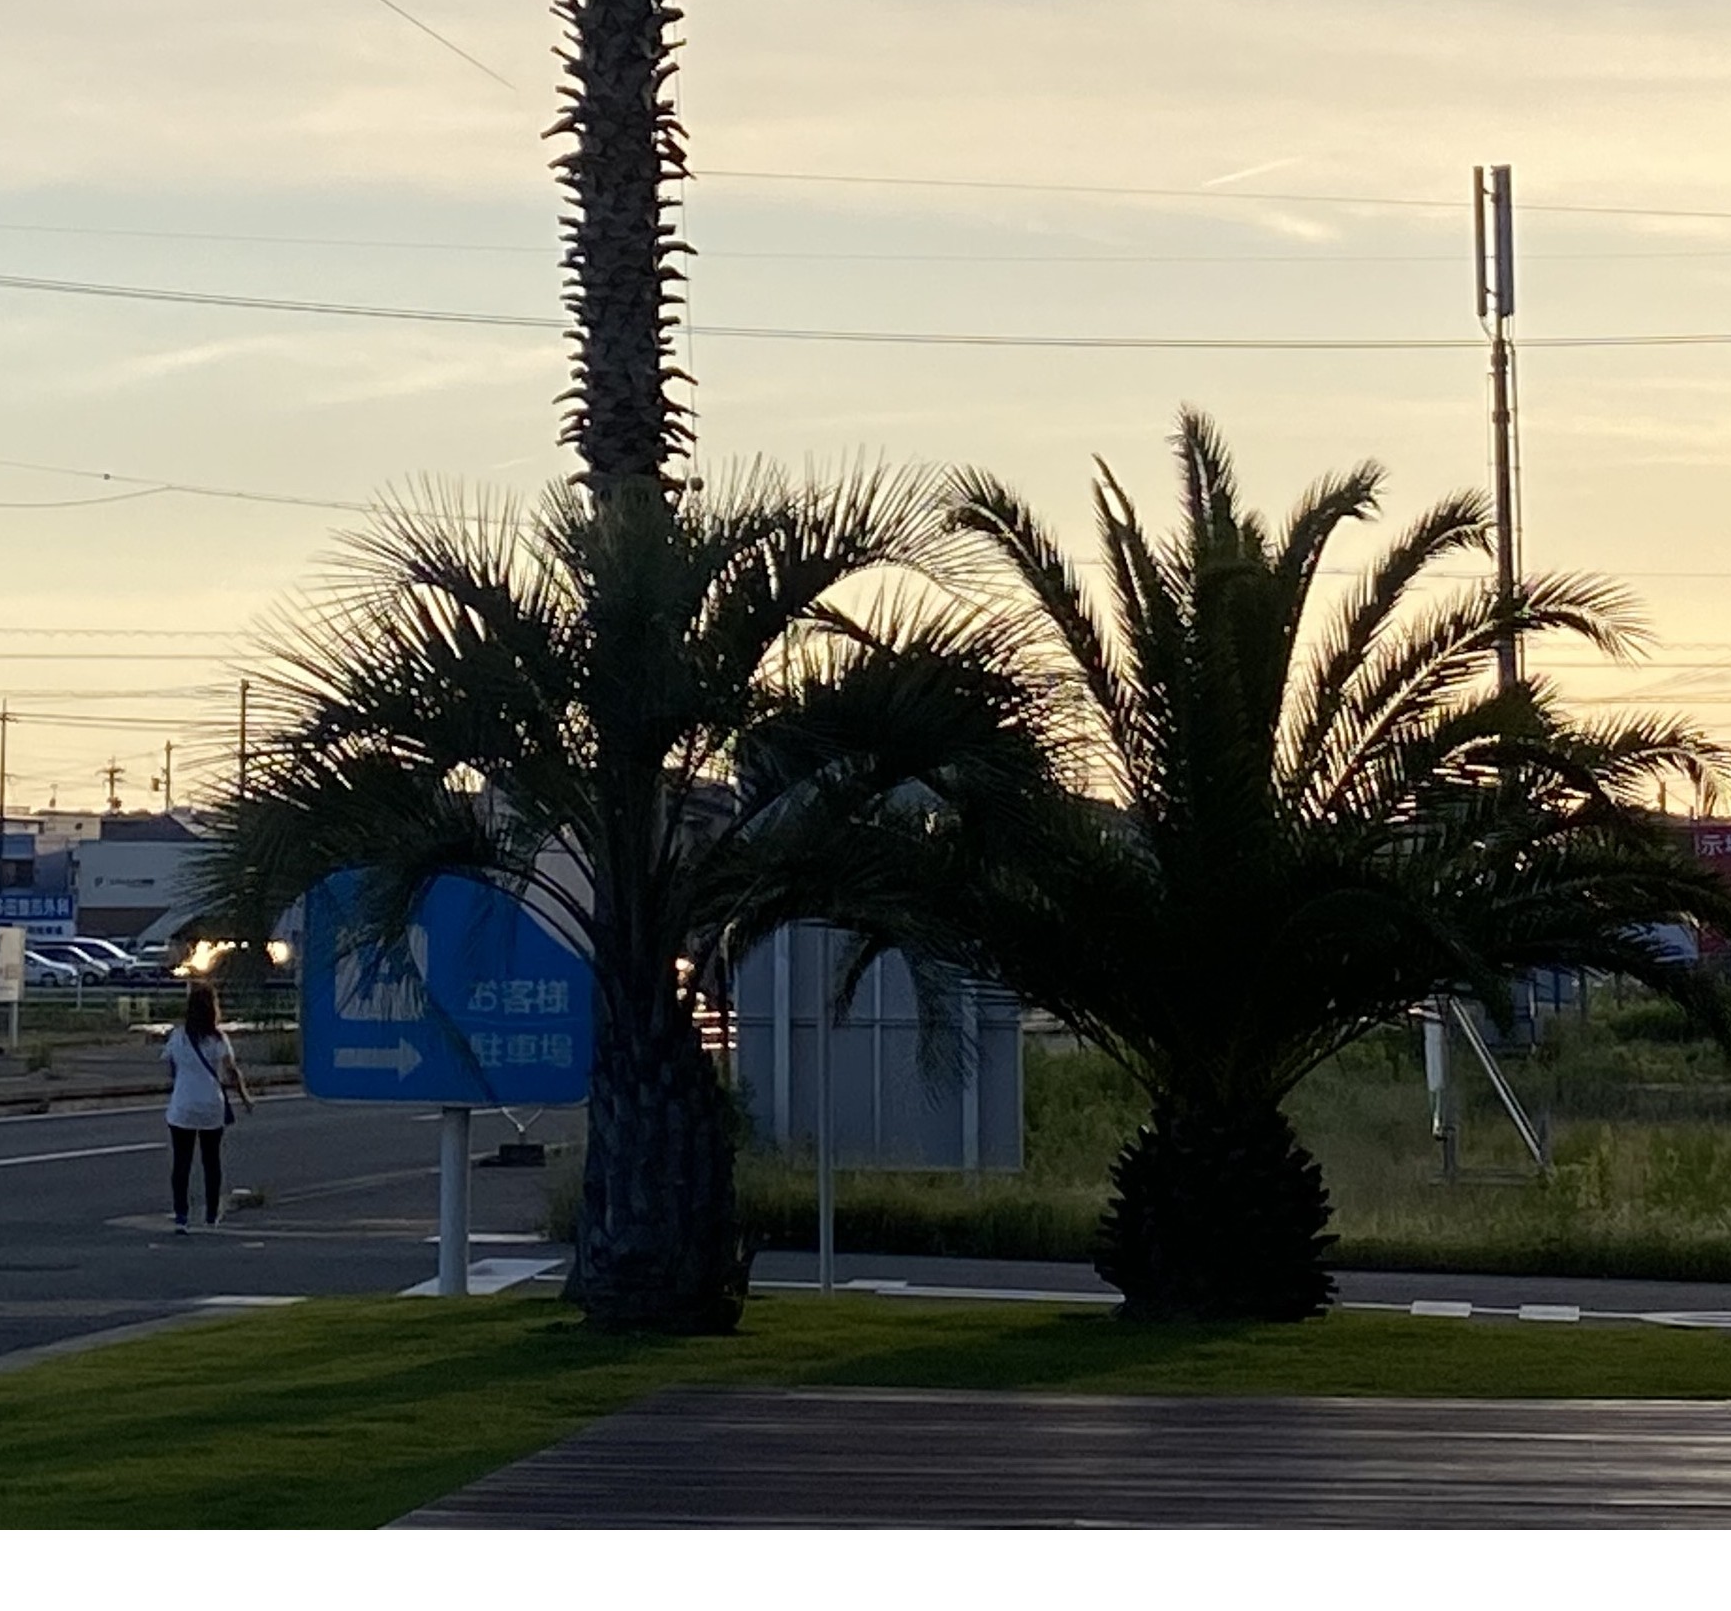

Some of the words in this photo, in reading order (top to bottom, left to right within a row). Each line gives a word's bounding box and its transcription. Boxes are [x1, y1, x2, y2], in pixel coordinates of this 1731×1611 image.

[467, 979, 570, 1014] お客様
[470, 1032, 573, 1069] 駐車場
